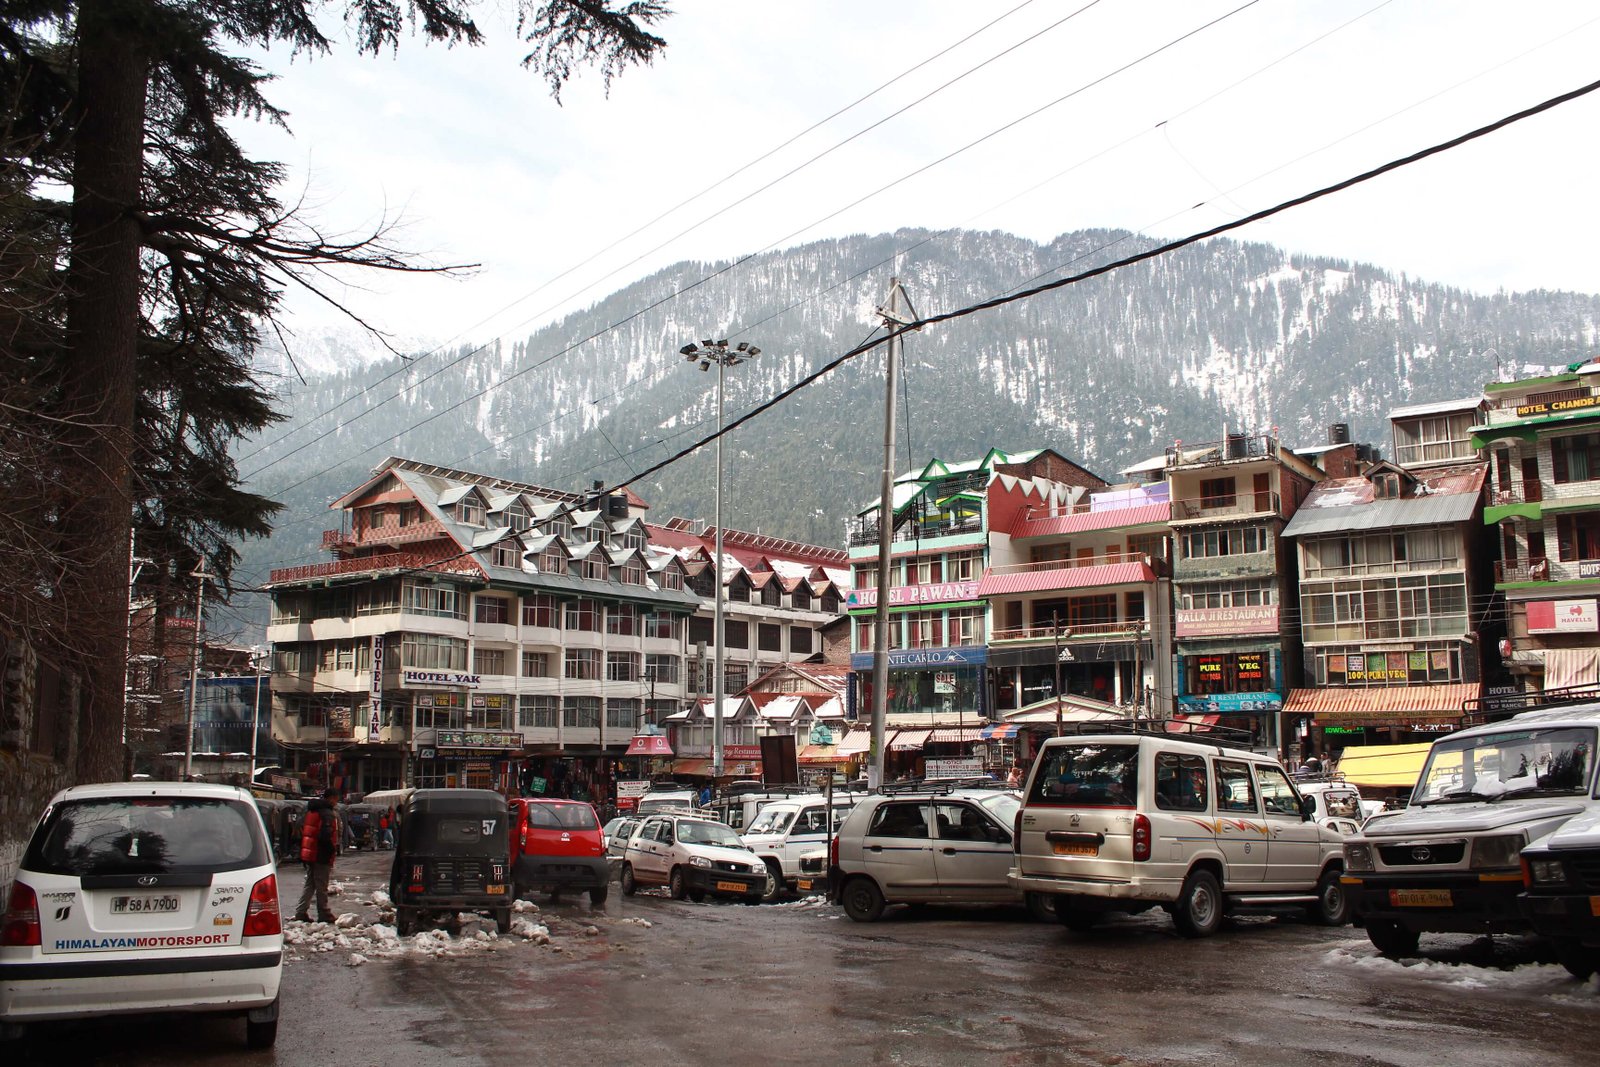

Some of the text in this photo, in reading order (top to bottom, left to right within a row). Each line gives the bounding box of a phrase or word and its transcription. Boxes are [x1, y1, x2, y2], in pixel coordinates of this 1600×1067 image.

[1518, 404, 1548, 414] HOTEL
[859, 589, 904, 606] HOEL
[910, 584, 966, 600] PAWAN
[1178, 608, 1277, 623] BALLA JI RESTAURANT
[888, 652, 941, 664] NTE CARLO
[374, 637, 382, 693] HOTEL
[1200, 662, 1260, 672] PURE VEG.
[407, 671, 480, 684] HOTEL YAK
[936, 674, 954, 683] SALE
[1348, 671, 1366, 680] 100%
[1369, 671, 1386, 680] PURE
[1489, 686, 1518, 695] HOTEL
[371, 700, 380, 734] YAK
[482, 819, 496, 836] 57
[214, 886, 244, 895] SANTRO
[114, 898, 178, 912] HP 58 A 7900
